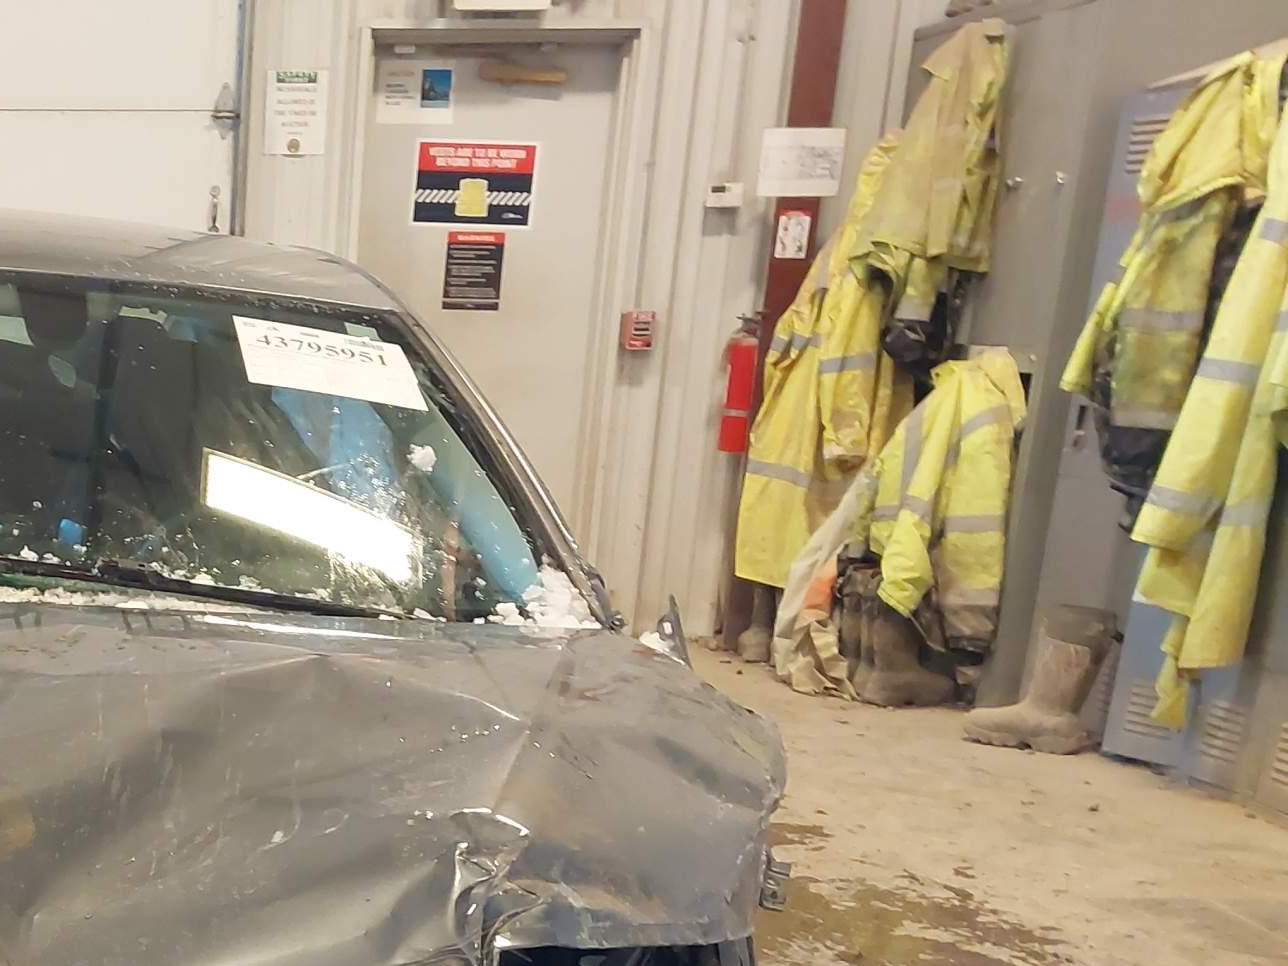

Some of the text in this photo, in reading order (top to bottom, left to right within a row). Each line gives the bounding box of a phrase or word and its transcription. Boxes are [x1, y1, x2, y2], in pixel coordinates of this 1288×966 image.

[435, 157, 470, 167] BEYOND
[491, 158, 518, 168] POINT
[255, 334, 388, 367] 43795951
